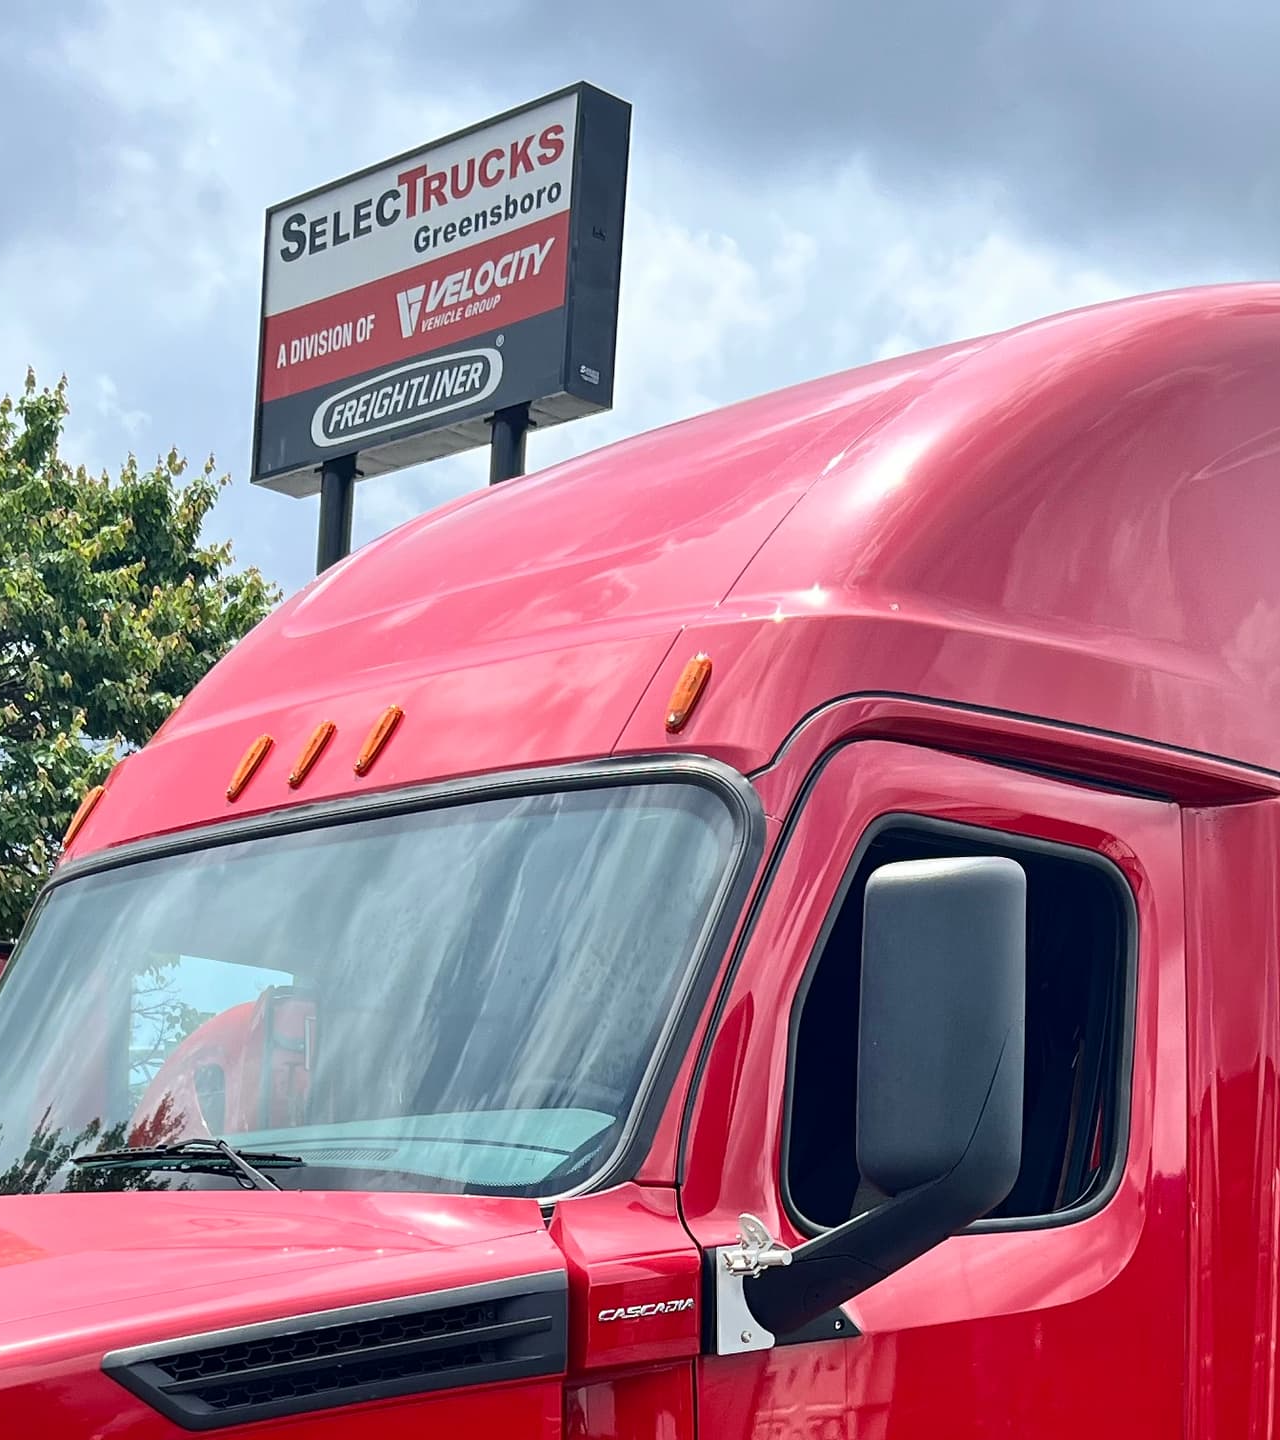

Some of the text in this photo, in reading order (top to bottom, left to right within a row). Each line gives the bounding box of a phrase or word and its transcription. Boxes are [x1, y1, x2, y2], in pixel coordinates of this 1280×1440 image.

[413, 182, 562, 254] Greensboro
[425, 237, 556, 313] VELOCITY
[276, 314, 376, 369] A DIVISION OF
[421, 294, 501, 333] VEHICLE GROUP
[328, 362, 484, 433] FREIGHTLINER
[597, 1297, 695, 1322] CASCADIA
